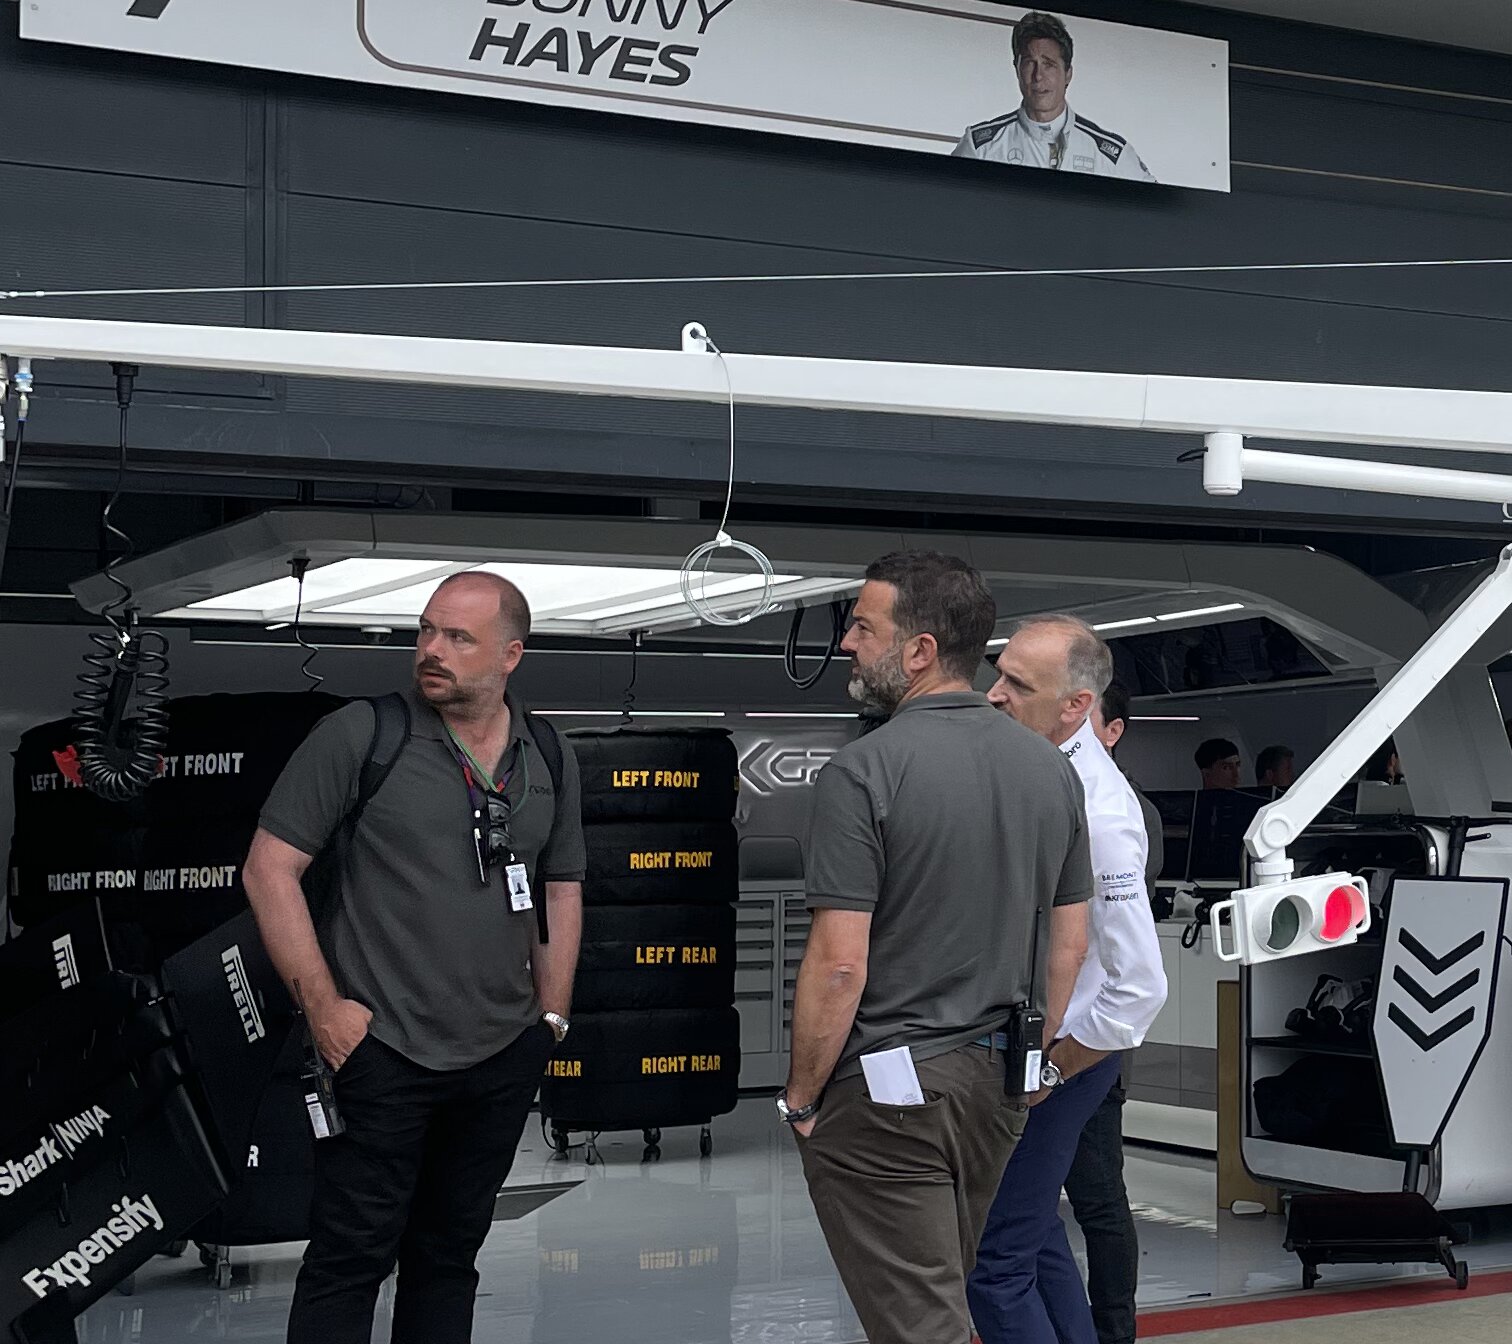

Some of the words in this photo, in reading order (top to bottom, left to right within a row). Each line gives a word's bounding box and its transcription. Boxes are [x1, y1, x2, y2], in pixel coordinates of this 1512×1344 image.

[468, 16, 700, 86] HAYES
[184, 753, 244, 776] FRONT
[30, 774, 57, 791] LEFT
[613, 770, 649, 787] LEFT
[654, 770, 700, 788] FRONT
[630, 852, 671, 869] RIGHT
[675, 851, 713, 868] FRONT
[48, 871, 91, 891] RIGHT
[144, 869, 176, 891] RIGHT
[180, 865, 237, 890] FRONT
[636, 946, 675, 964] LEFT
[682, 946, 717, 964] REAR
[221, 944, 266, 1043] PIRELLI
[553, 1060, 582, 1077] REAR
[641, 1056, 687, 1074] RIGHT
[691, 1055, 721, 1072] REAR
[22, 1193, 163, 1298] Expensify
